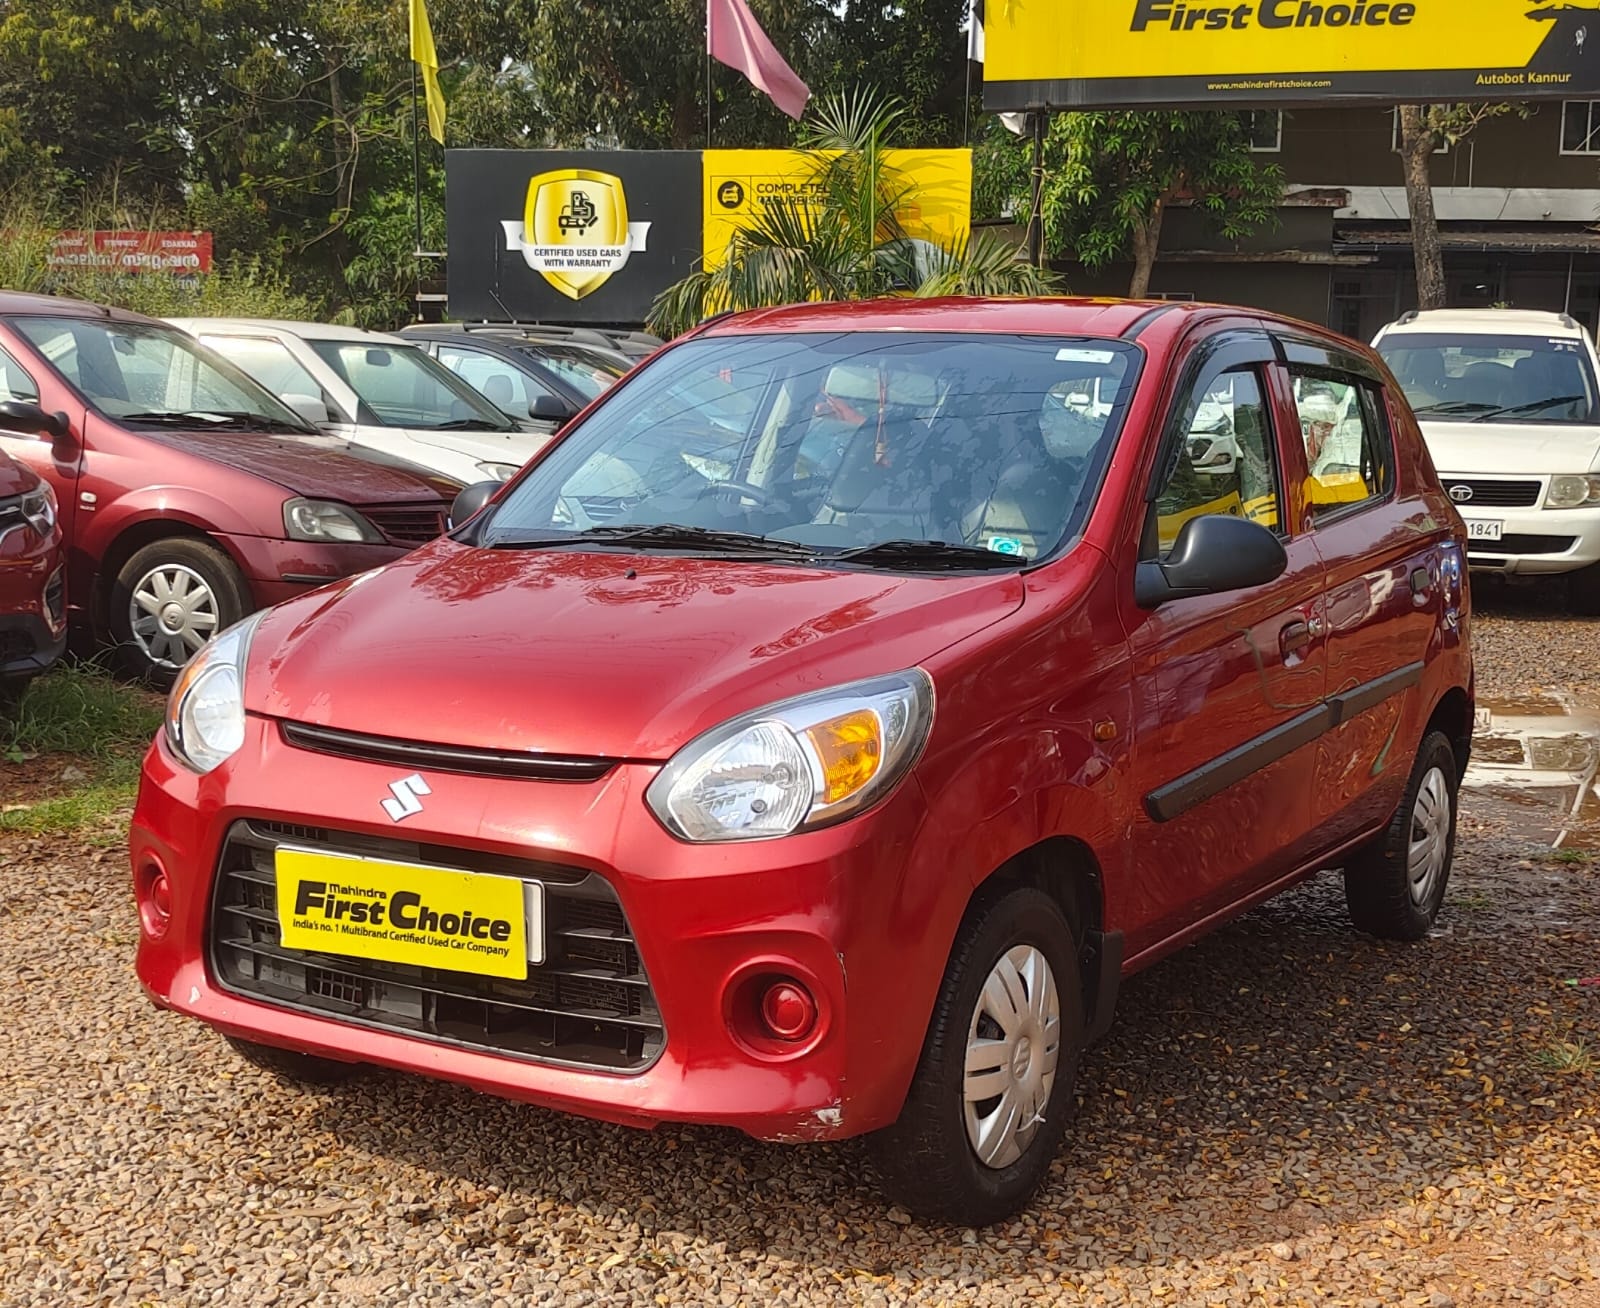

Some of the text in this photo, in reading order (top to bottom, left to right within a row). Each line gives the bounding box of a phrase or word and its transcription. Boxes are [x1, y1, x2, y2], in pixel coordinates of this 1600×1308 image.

[1129, 0, 1416, 31] First Choice
[1207, 79, 1332, 90] www.mahindrafirstchoice.com
[1476, 72, 1572, 85] Autobot Kannur
[756, 183, 832, 194] COMPLETEL
[534, 249, 621, 257] CERTIFIED USED CARS
[544, 259, 612, 267] WITH WARRANTY
[1469, 523, 1499, 537] 1841
[329, 883, 387, 899] Mahindra
[294, 879, 512, 942] First Choice
[292, 919, 319, 930] India's
[320, 924, 333, 932] no.
[341, 925, 388, 939] Multibrand
[389, 930, 426, 945] Certified
[427, 936, 450, 948] Used
[450, 939, 465, 949] Car
[466, 941, 510, 958] Company
